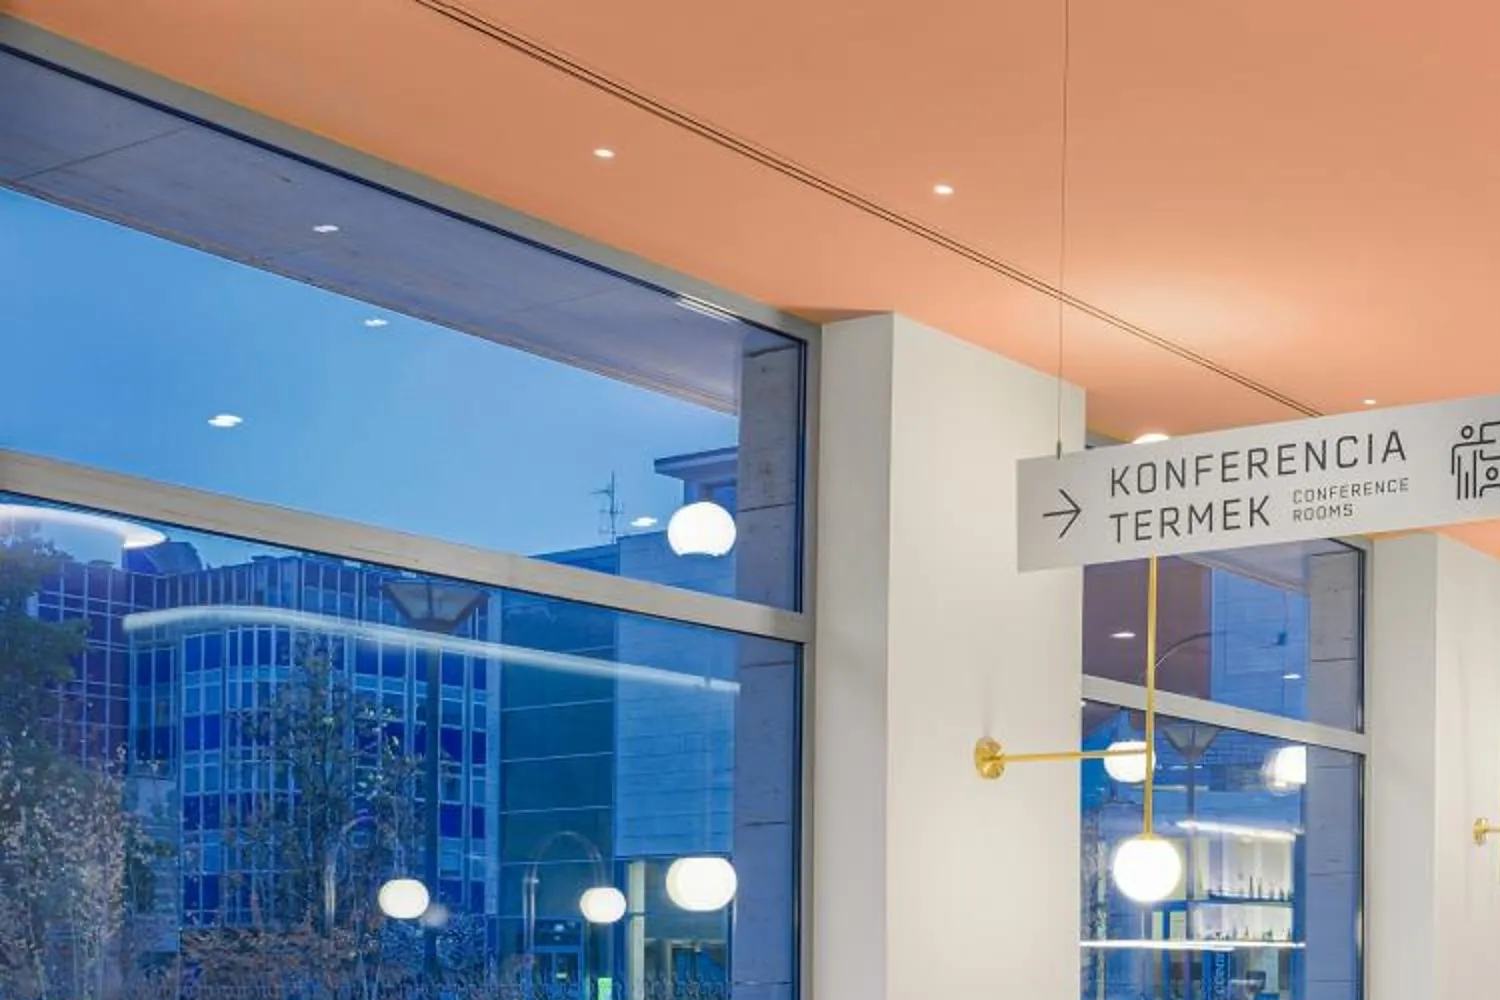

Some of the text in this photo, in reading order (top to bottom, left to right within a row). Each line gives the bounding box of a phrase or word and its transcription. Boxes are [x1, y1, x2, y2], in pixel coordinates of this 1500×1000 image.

[1110, 430, 1406, 497] KONFERENCIA
[1293, 477, 1409, 504] CONFERENCE
[1109, 495, 1270, 543] TERMEK
[1293, 503, 1353, 521] ROOMS
